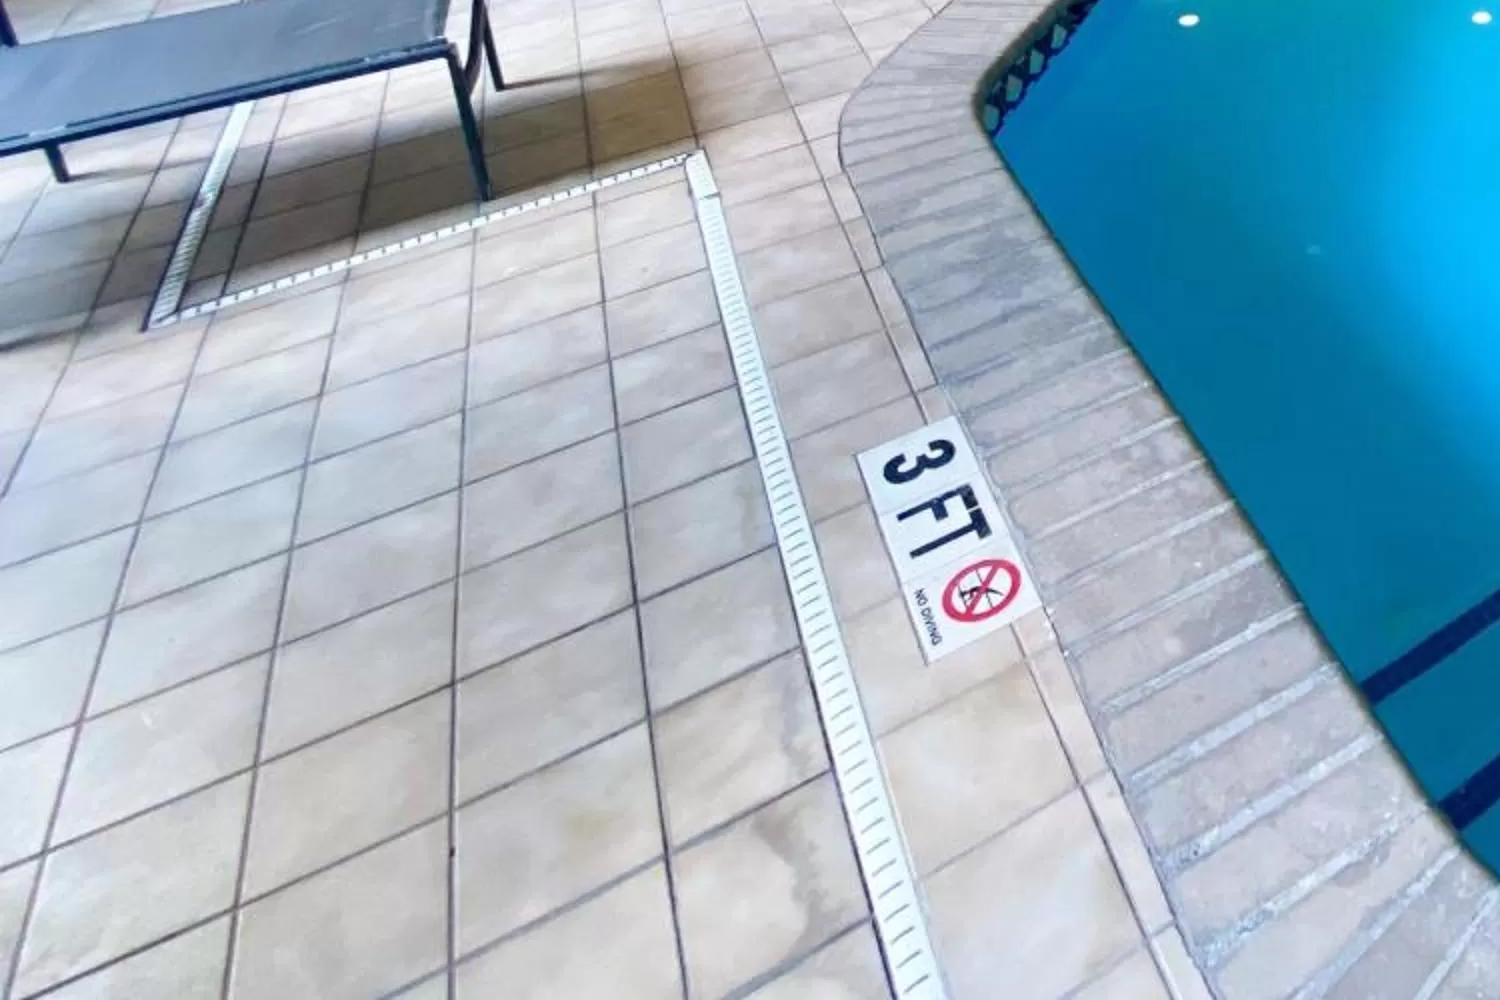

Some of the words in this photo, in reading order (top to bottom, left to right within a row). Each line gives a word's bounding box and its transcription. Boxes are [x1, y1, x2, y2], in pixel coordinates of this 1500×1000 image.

[883, 439, 956, 485] 3
[896, 483, 993, 559] FT
[913, 588, 929, 606] NO
[920, 606, 943, 646] DIVING
